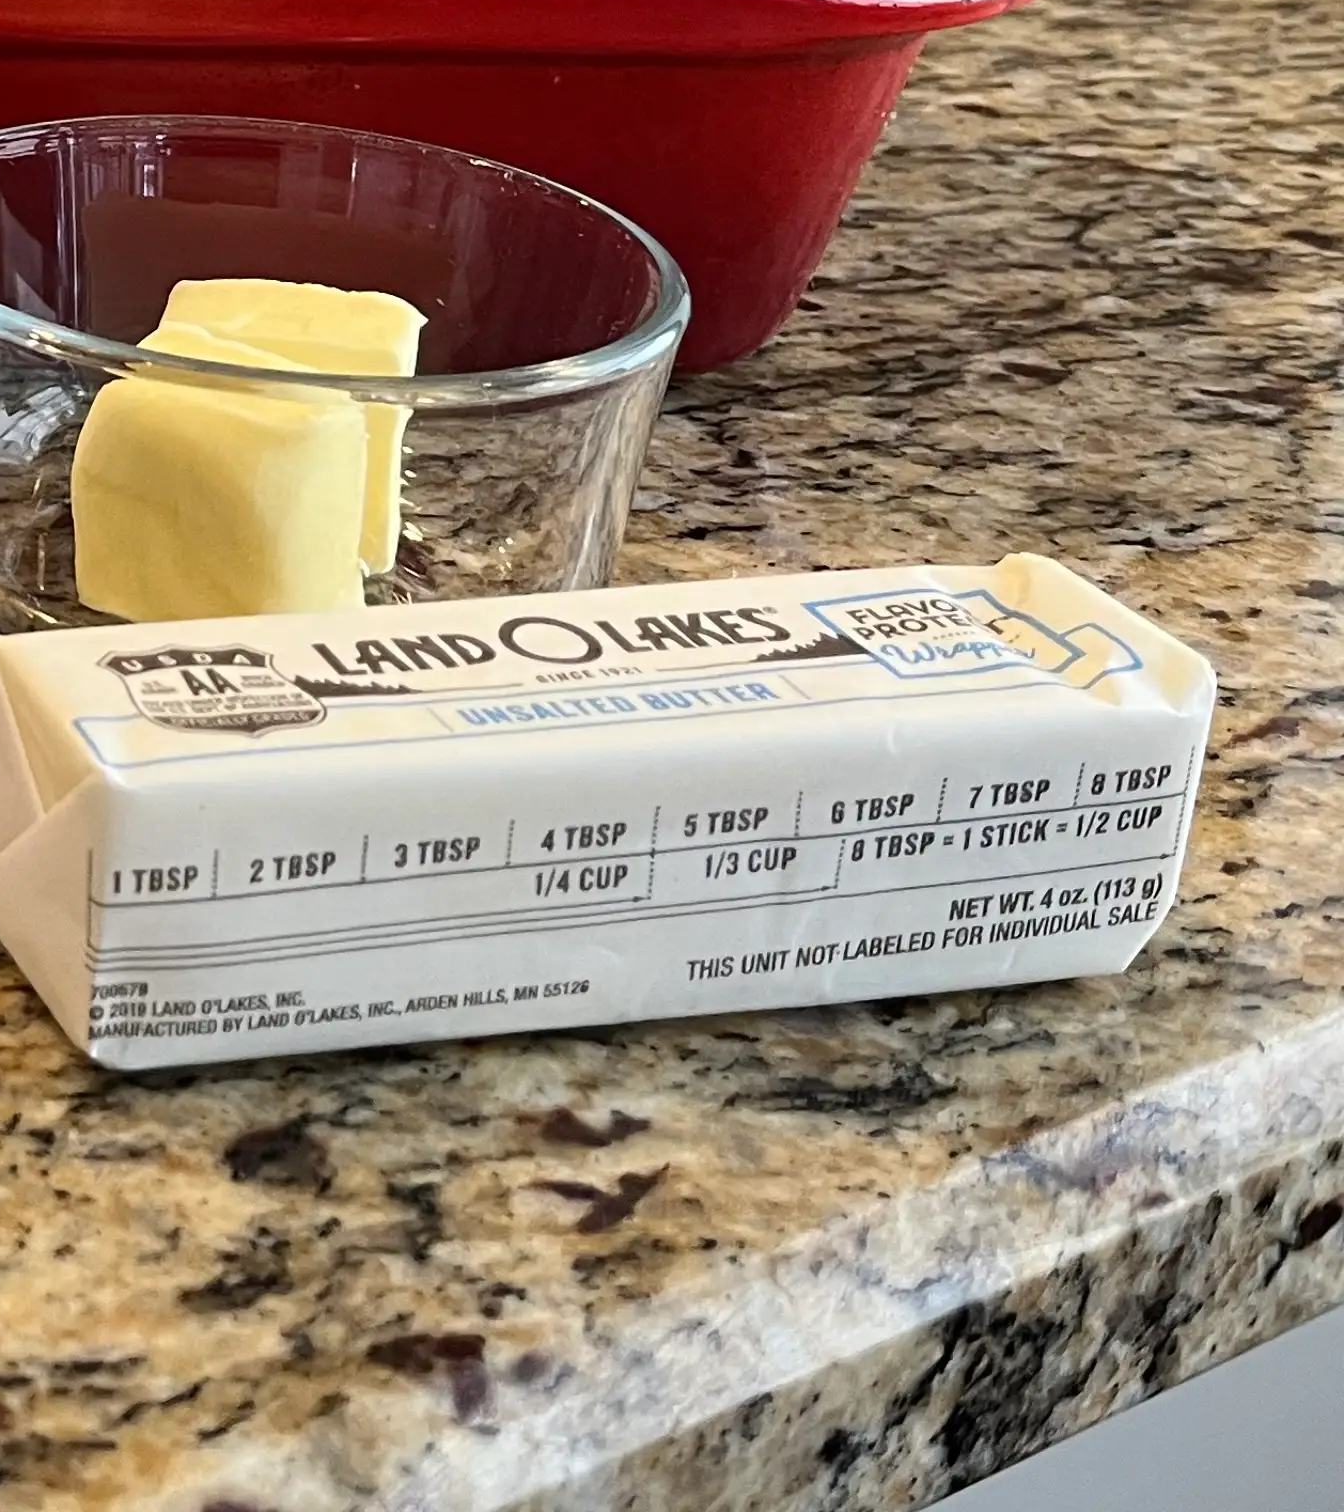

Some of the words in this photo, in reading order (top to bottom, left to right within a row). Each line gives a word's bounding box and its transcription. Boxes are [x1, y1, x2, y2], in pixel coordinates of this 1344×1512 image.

[846, 599, 959, 625] FLAVO
[853, 613, 972, 640] PROTE
[312, 633, 497, 677] LAND
[498, 616, 604, 664] O
[594, 606, 792, 654] LAKES
[179, 667, 244, 696] AA
[535, 668, 596, 684] SINCE
[458, 691, 637, 727] UNSALTED
[642, 682, 781, 711] BUTTER
[968, 785, 983, 809] 7
[991, 779, 1050, 808] TBSP
[1091, 773, 1106, 795] 8
[1115, 765, 1171, 793] TBSP
[684, 813, 699, 837] 5
[708, 807, 768, 835] TBSP
[831, 800, 845, 825] 6
[855, 793, 915, 822] TBSP
[540, 829, 555, 852] 4
[564, 822, 627, 850] TBSP
[851, 839, 865, 862] 8
[875, 831, 936, 859] TBSP
[963, 827, 972, 851] 1
[980, 818, 1050, 848] STICK
[1076, 810, 1111, 838] 1/2
[1117, 805, 1163, 832] CUP
[249, 859, 264, 884] 2
[273, 851, 337, 880] TBSP
[394, 843, 408, 868] 3
[418, 837, 481, 866] TBSP
[705, 850, 740, 879] 1/3
[748, 846, 797, 873] CUP
[112, 870, 121, 894] 1
[132, 865, 199, 893] TBSP
[535, 867, 570, 898] 1/4
[579, 864, 629, 892] CUP
[949, 895, 994, 922] NET
[999, 890, 1034, 914] WT.
[1039, 887, 1053, 910] 4
[1058, 887, 1088, 907] oz.
[1093, 876, 1135, 906] (113
[1140, 872, 1164, 900] g)
[687, 955, 735, 981] THIS
[741, 949, 791, 976] UNIT
[795, 943, 839, 969] NOT
[843, 931, 936, 961] LABELED
[942, 925, 985, 950] FOR
[989, 909, 1101, 944] INDIVIDUAL
[1108, 900, 1160, 926] SALE
[89, 1018, 217, 1040] MANUFACTURED
[223, 1015, 241, 1033] BY
[248, 1011, 289, 1031] LAND
[405, 994, 458, 1014] ARDEN
[463, 988, 509, 1007] HILLS,
[513, 984, 539, 1002] MN
[544, 979, 591, 998] 55126
[152, 999, 196, 1017] LAND
[276, 991, 306, 1008] INC.
